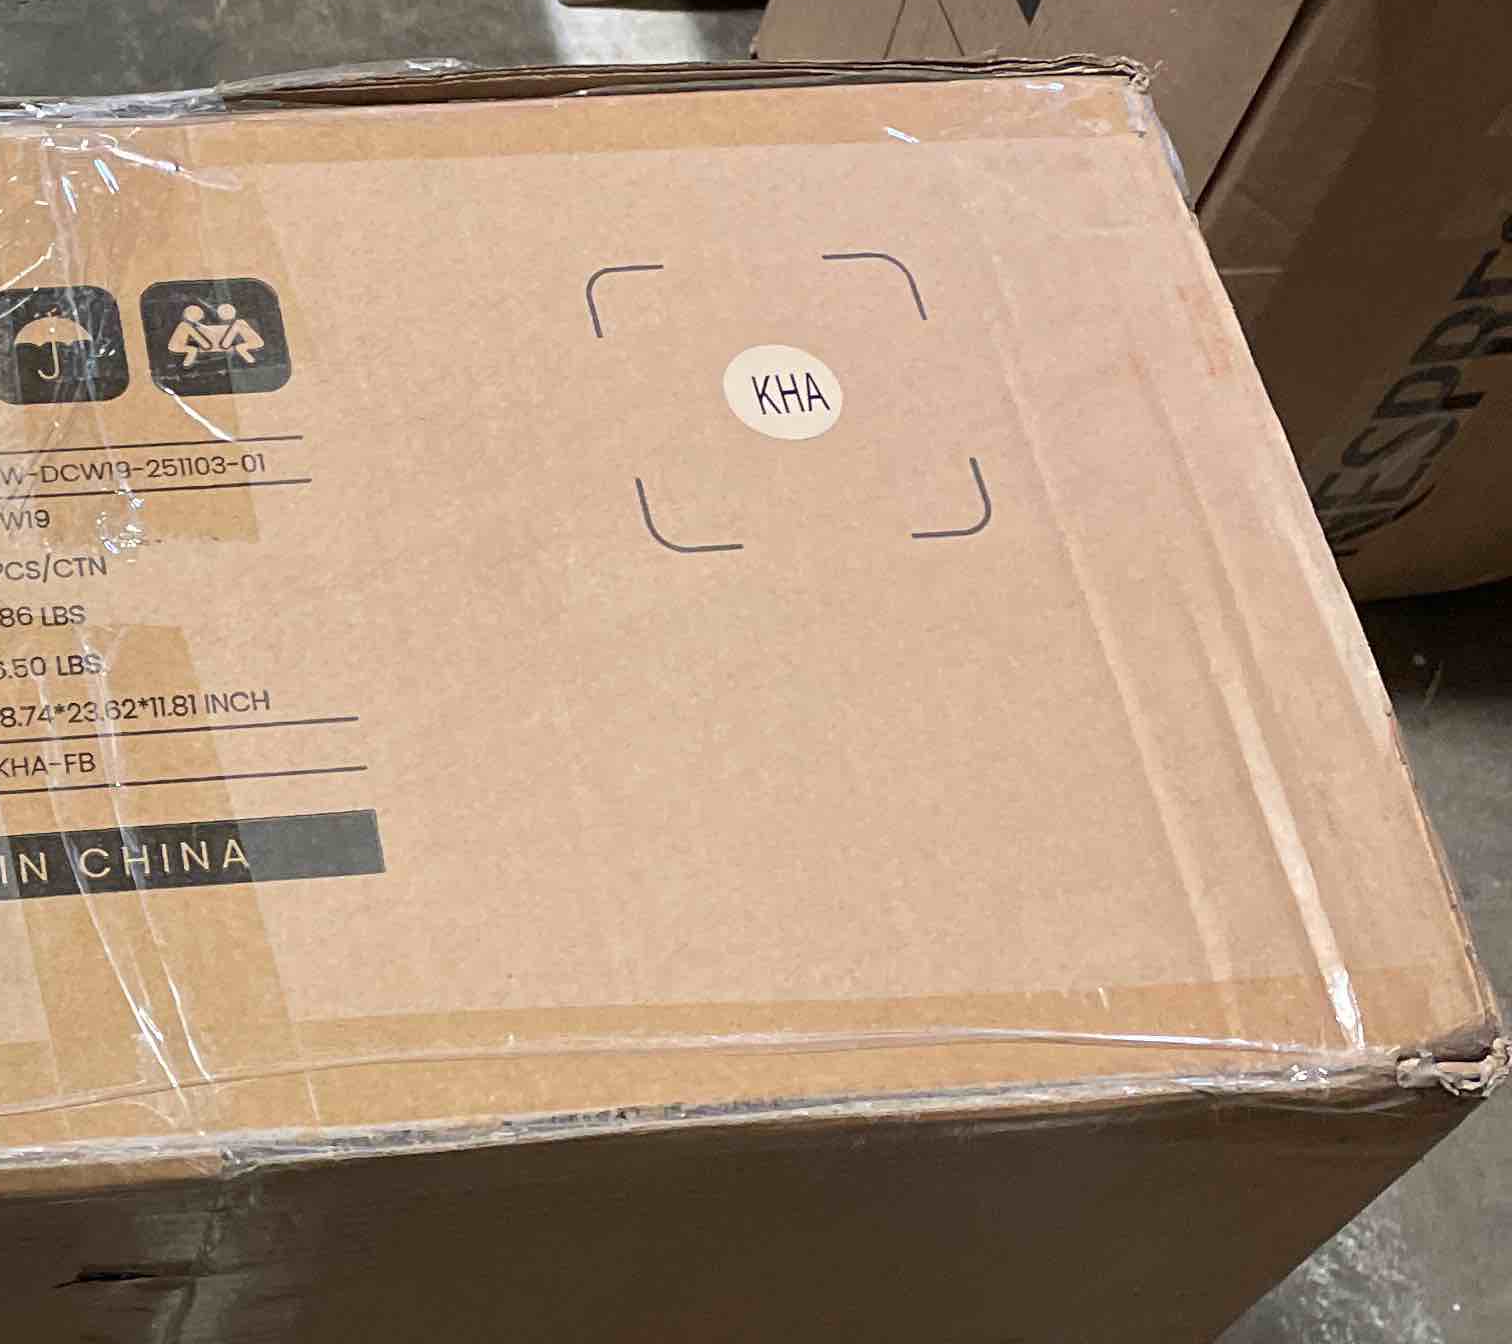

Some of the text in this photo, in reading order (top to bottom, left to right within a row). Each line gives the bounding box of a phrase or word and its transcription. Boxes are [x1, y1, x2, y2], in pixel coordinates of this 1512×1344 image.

[751, 371, 831, 416] KHA
[40, 605, 87, 628] LBS
[56, 654, 105, 677] LBS
[202, 688, 271, 715] INCH
[0, 850, 50, 885] IN
[77, 837, 252, 880] CHINA
